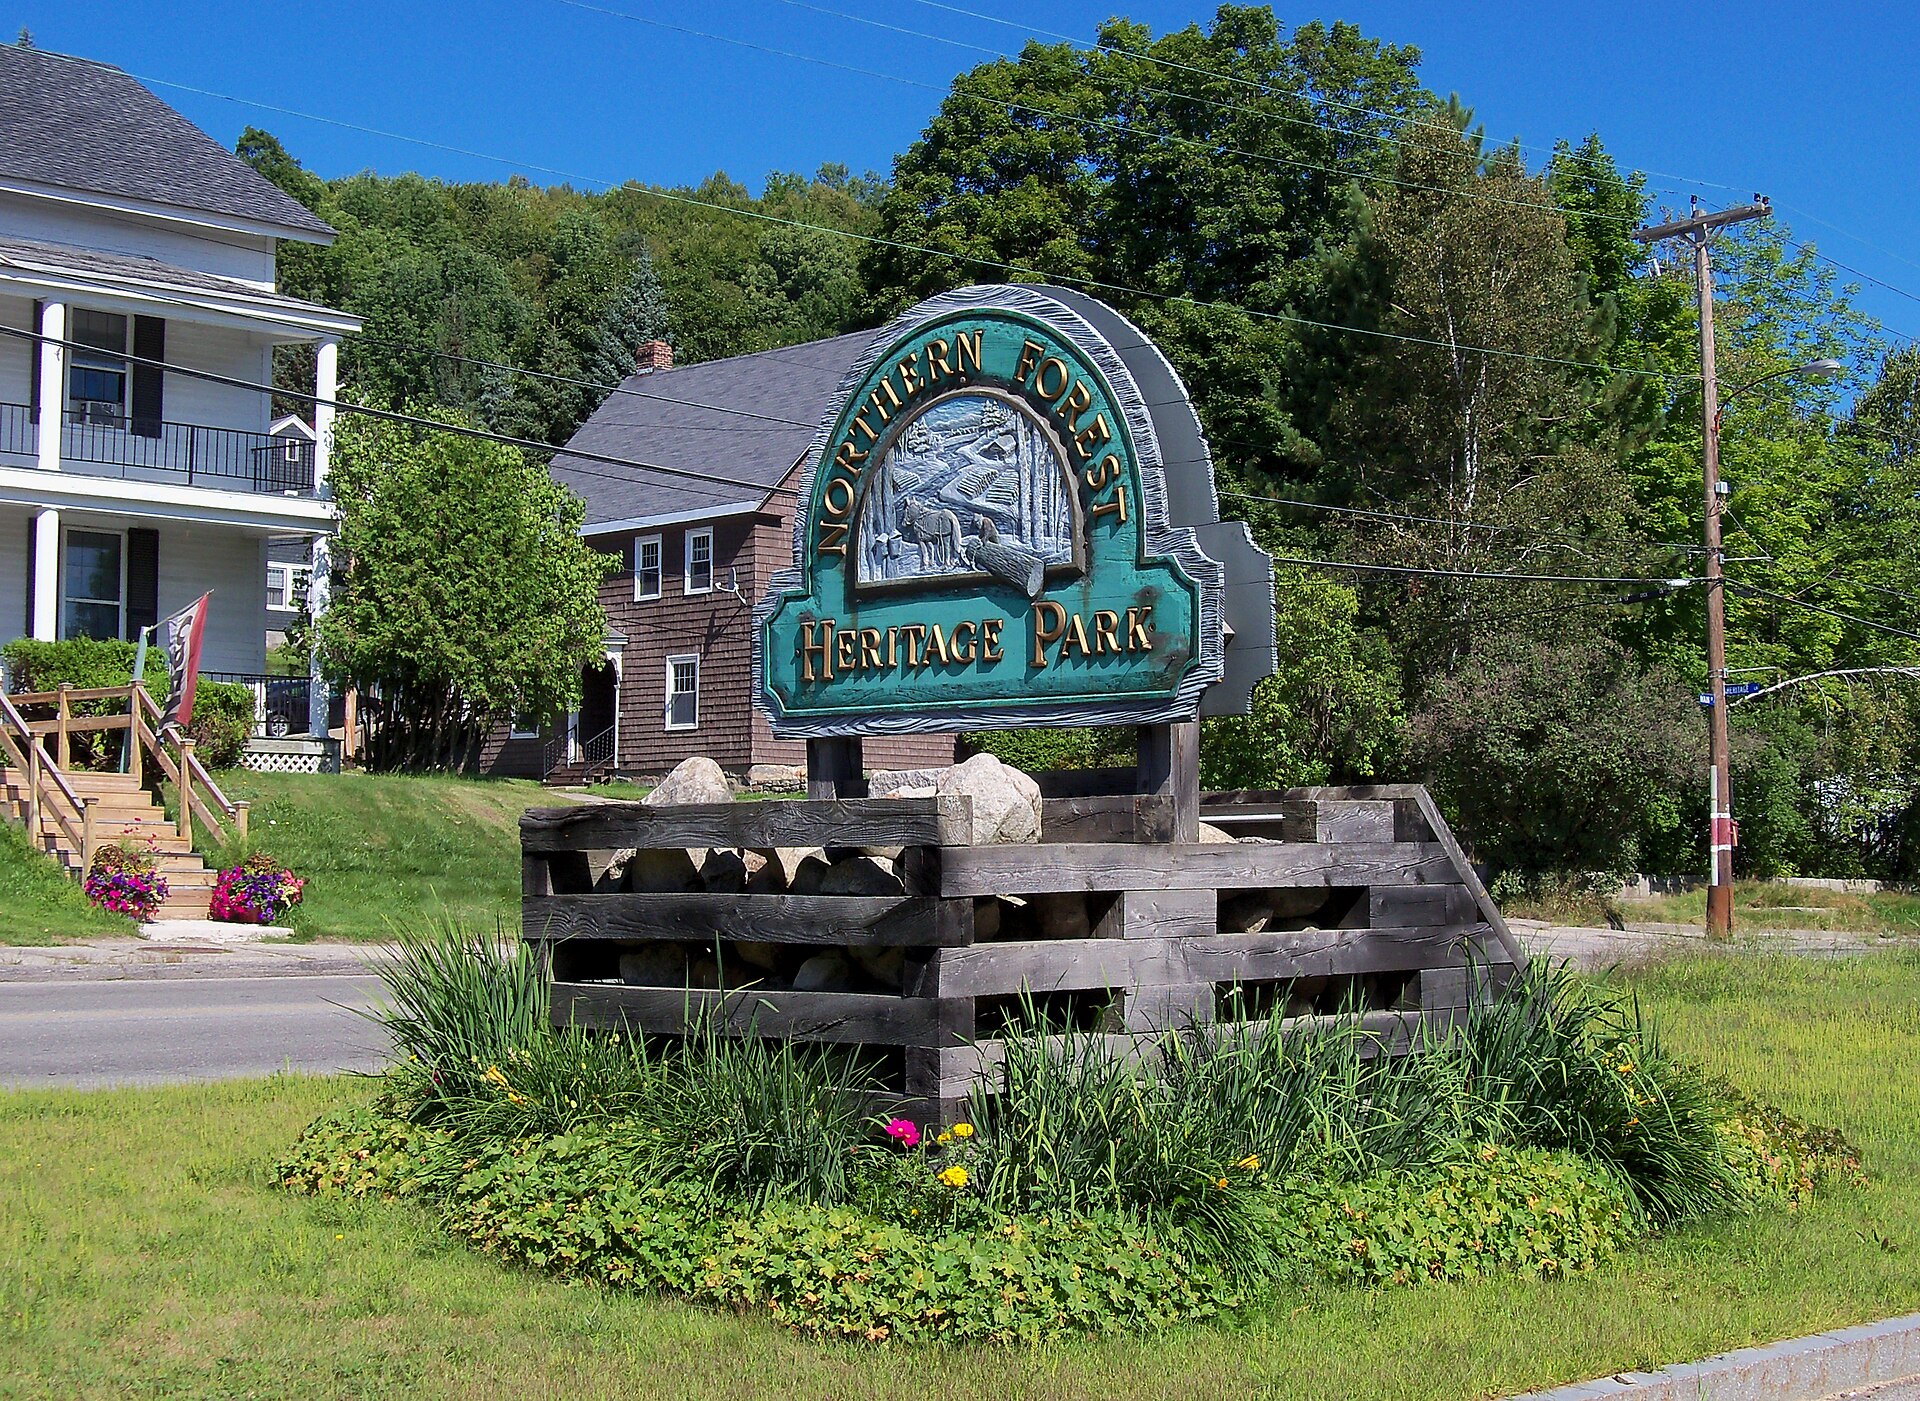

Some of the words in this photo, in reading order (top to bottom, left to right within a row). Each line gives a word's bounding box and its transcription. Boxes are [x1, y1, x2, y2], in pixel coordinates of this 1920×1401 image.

[819, 329, 984, 557] NORTHERN
[1014, 340, 1128, 522] FOREST
[800, 618, 1005, 682] HERITAGE
[1030, 600, 1153, 668] PARK
[1725, 685, 1749, 694] HERITAGE
